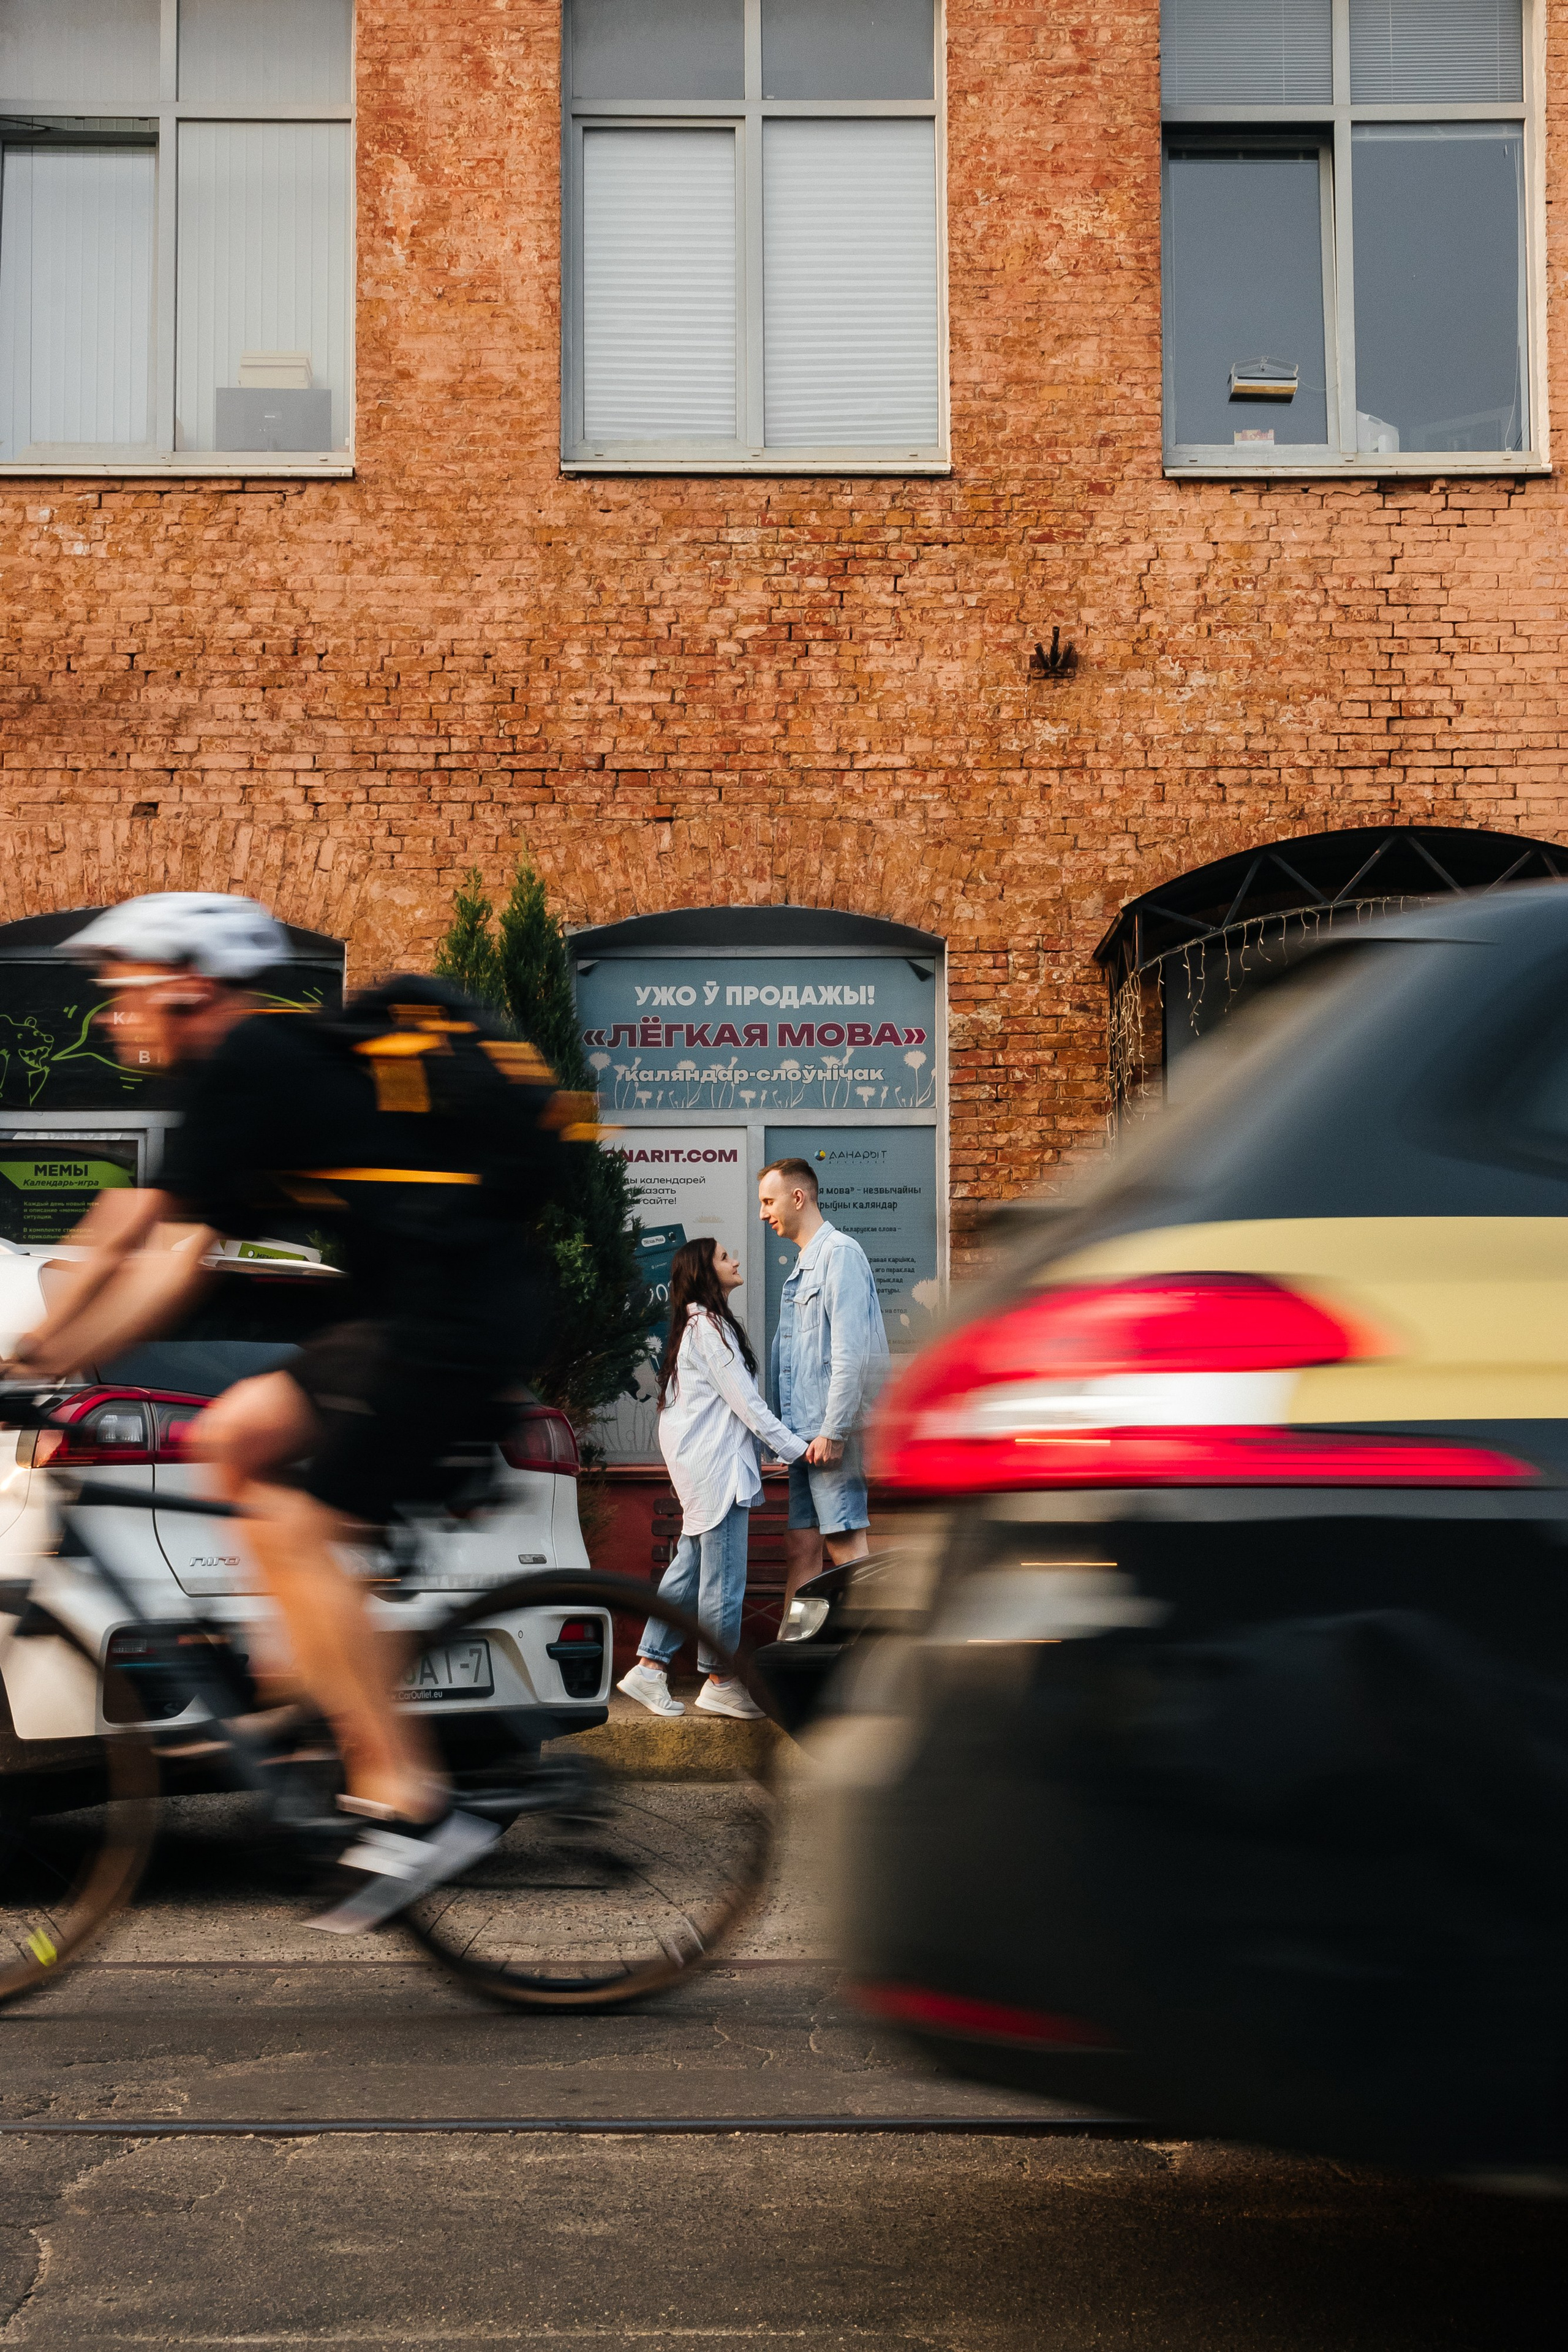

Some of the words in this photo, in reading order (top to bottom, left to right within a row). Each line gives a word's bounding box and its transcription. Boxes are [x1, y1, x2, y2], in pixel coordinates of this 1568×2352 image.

[635, 986, 696, 1006] УЖО
[703, 981, 718, 1006] Ў
[726, 986, 875, 1009] ПРОДАЖЫ!
[582, 1016, 772, 1049] «ЛЁГКАЯ
[777, 1023, 927, 1048] МОВА»
[624, 1064, 884, 1084] каляндар-слоўнічак
[34, 1164, 88, 1177] МЕМЫ
[640, 1176, 706, 1185] календарей
[863, 1186, 921, 1194] незвычайны
[818, 1200, 851, 1212] рыўны
[853, 1202, 898, 1212] каляндар
